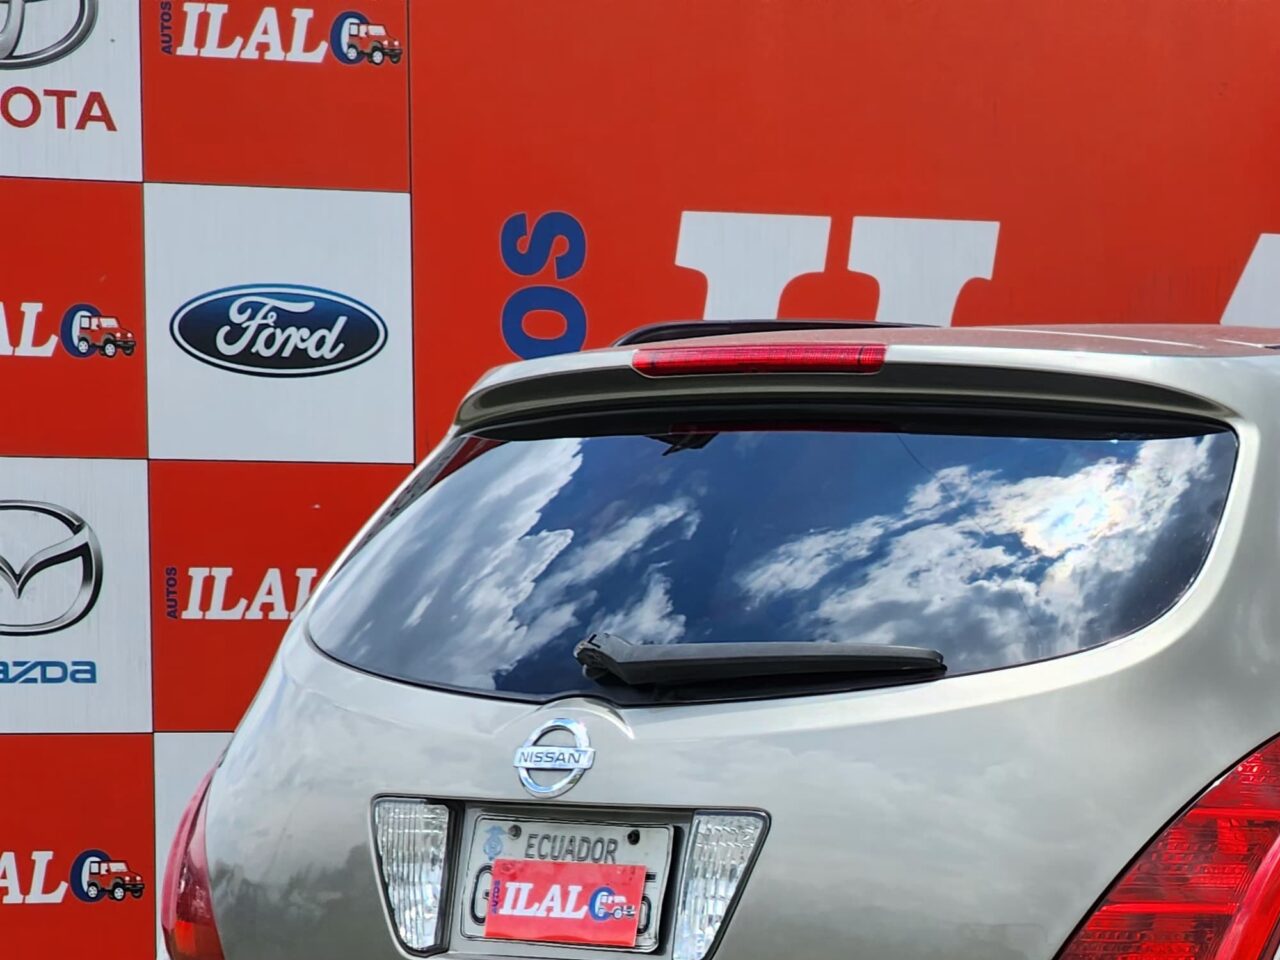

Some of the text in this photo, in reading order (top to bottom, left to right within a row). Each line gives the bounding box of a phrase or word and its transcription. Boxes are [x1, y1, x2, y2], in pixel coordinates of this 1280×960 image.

[160, 1, 173, 55] AUTOS
[0, 87, 118, 132] OTA
[216, 296, 348, 360] Ford
[165, 566, 178, 619] AUTOS
[519, 750, 582, 764] NISSAN
[525, 833, 619, 864] ECUADOR
